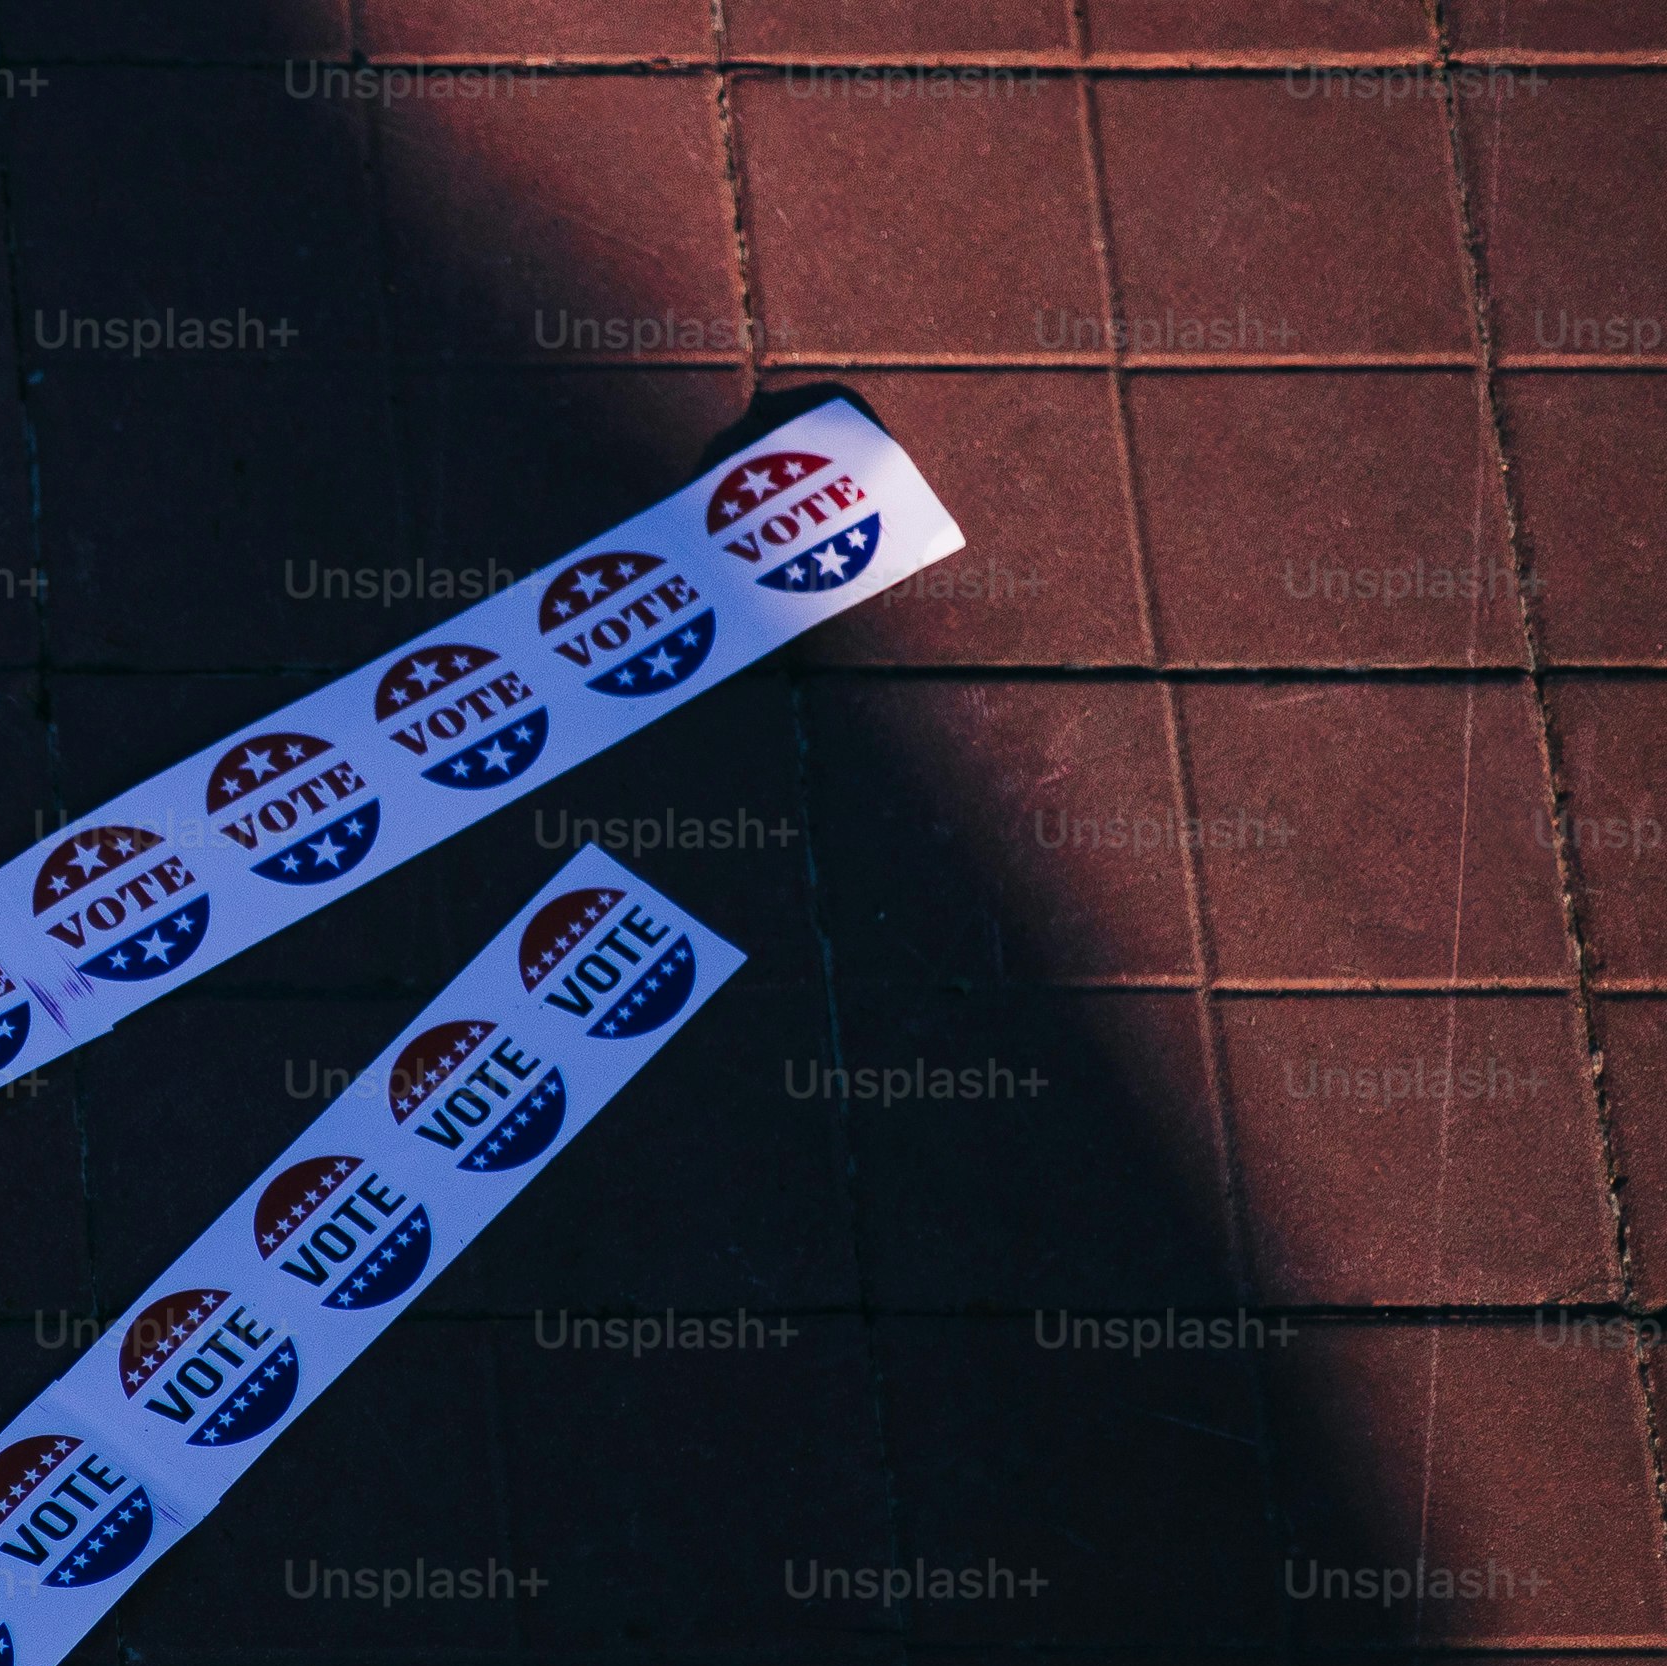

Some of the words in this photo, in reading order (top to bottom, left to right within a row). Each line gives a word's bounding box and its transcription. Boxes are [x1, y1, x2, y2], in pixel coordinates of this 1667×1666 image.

[724, 475, 866, 564] VOTE
[554, 574, 700, 669] VOTE
[389, 671, 533, 757] VOTE
[219, 761, 366, 851] VOTE
[46, 855, 196, 950] VOTE
[543, 904, 670, 1019] VOTE
[414, 1035, 541, 1152] VOTE
[279, 1172, 407, 1288] VOTE
[143, 1305, 276, 1425] VOTE
